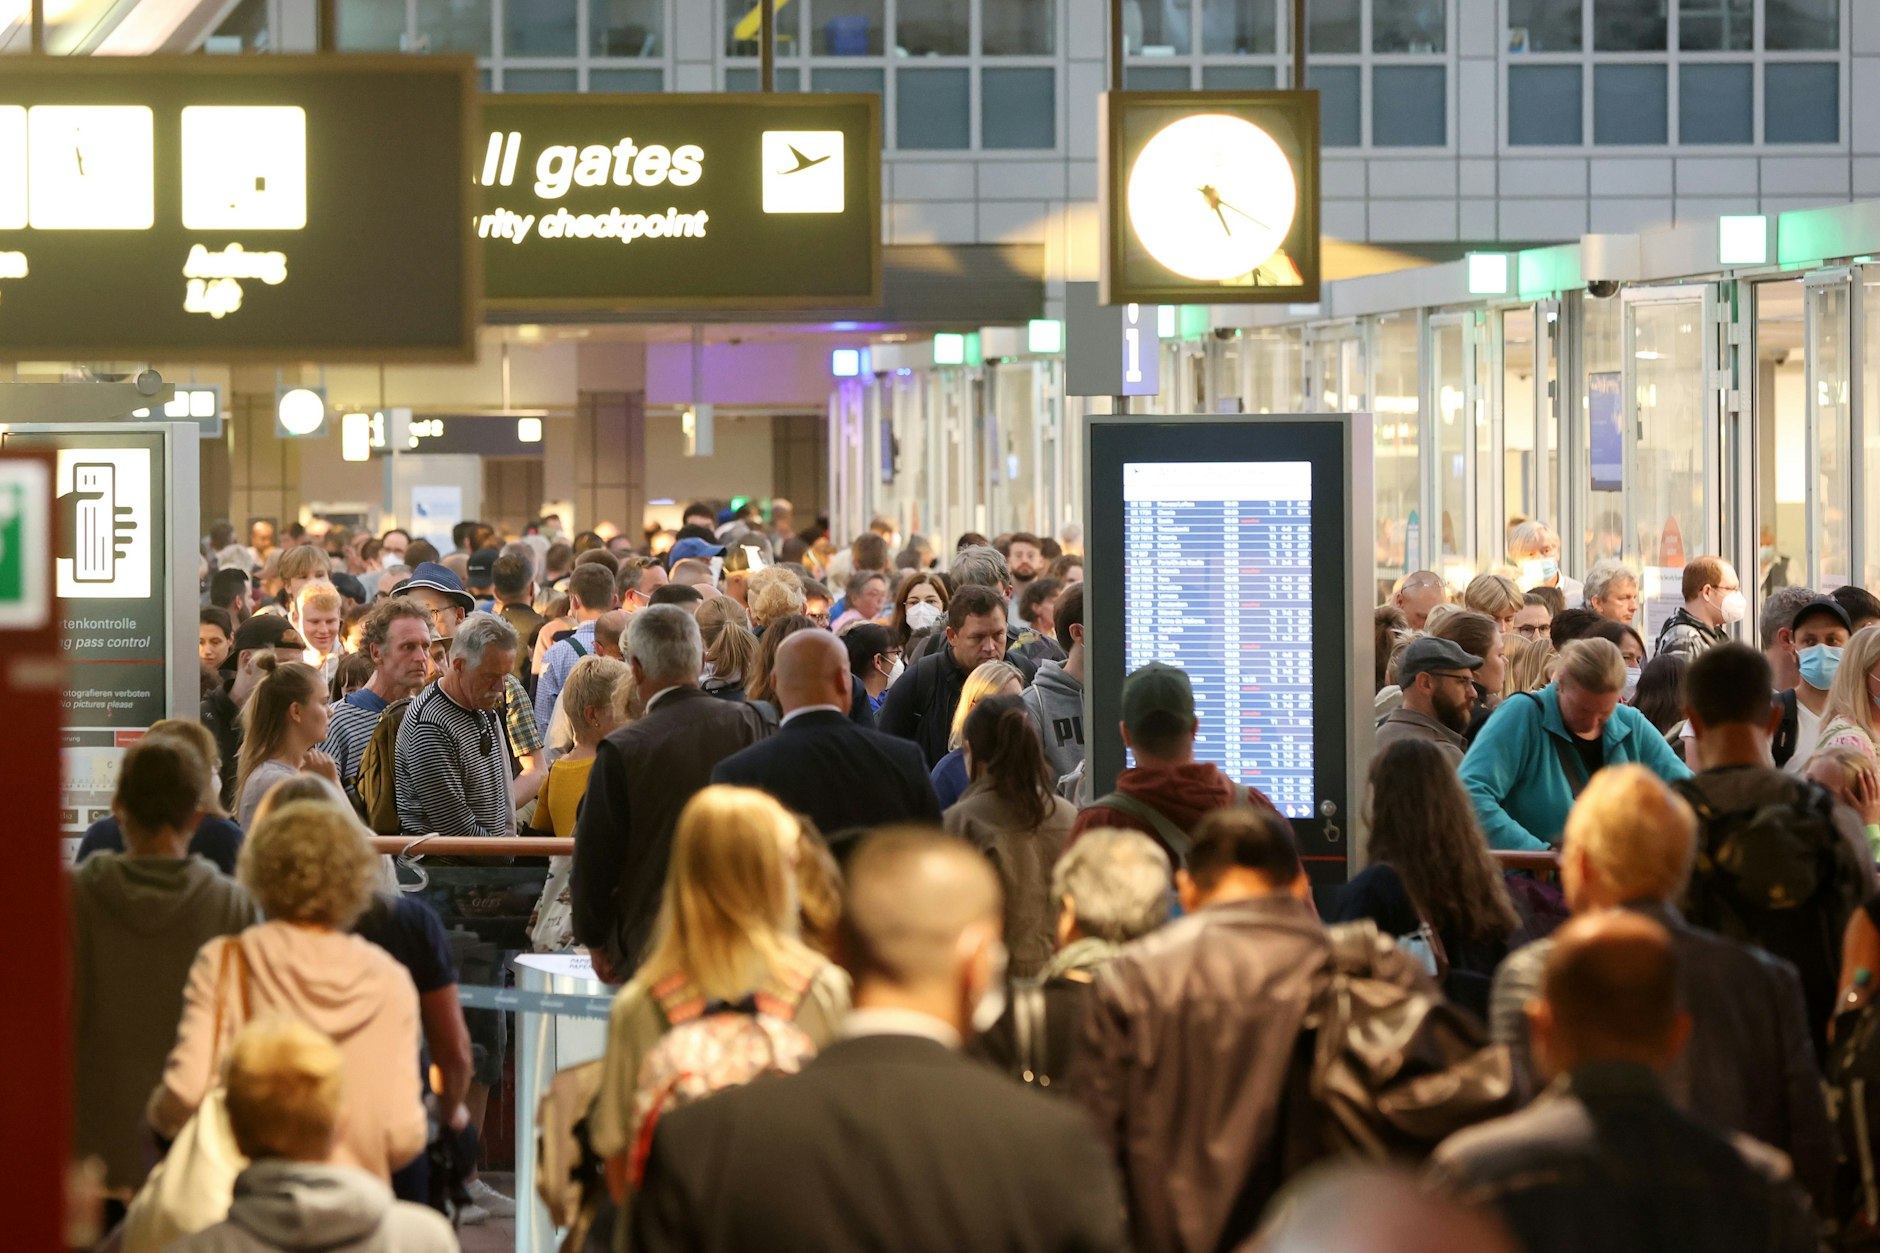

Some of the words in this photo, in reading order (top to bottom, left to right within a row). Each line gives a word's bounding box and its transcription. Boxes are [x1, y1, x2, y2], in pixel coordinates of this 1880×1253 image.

[473, 132, 522, 186] ll
[533, 137, 705, 199] gates
[473, 207, 535, 244] rity
[538, 207, 709, 244] checkpoint
[76, 638, 105, 650] pass
[107, 636, 151, 647] control
[114, 689, 151, 697] verboten
[73, 700, 105, 709] pictures
[107, 700, 134, 709] please
